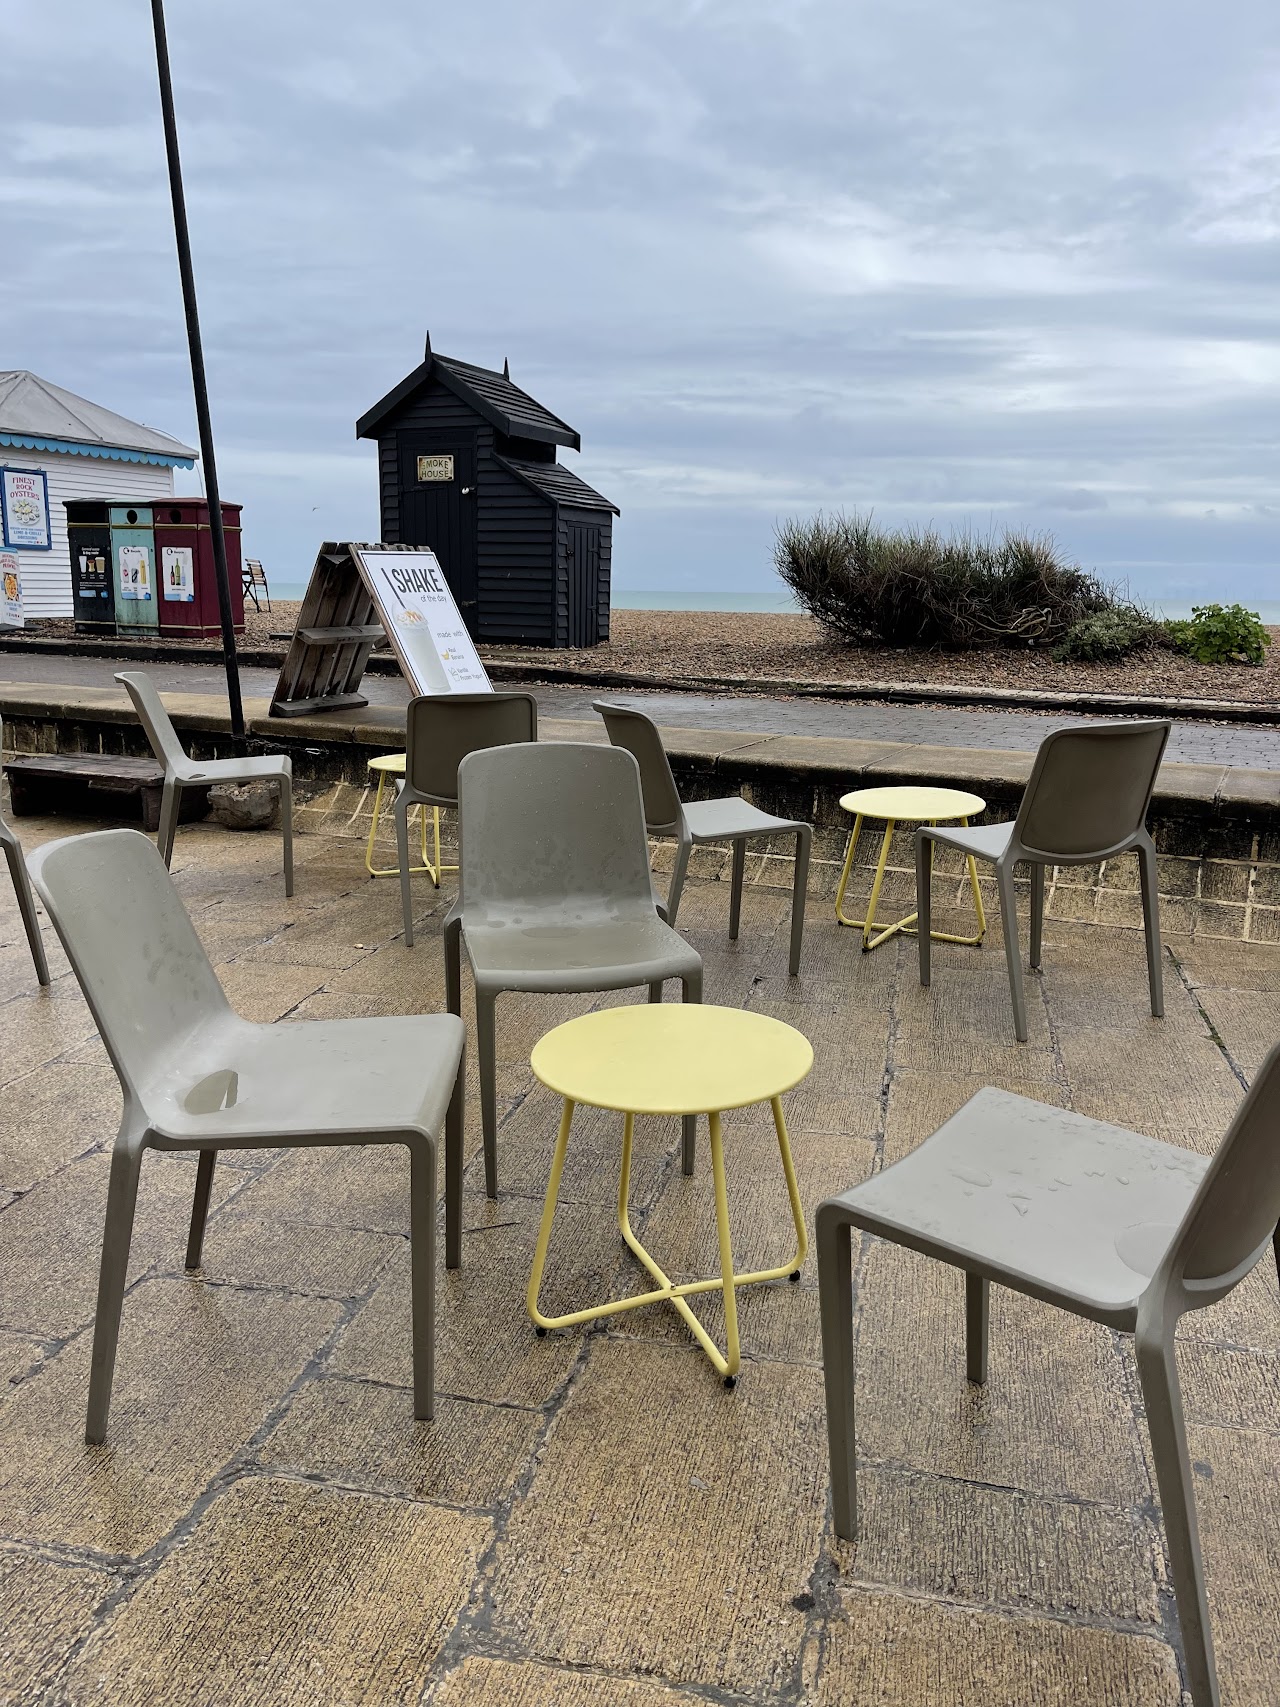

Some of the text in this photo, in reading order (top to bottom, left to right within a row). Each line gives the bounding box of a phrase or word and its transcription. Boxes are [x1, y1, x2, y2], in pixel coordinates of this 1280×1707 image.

[421, 470, 449, 478] HOUSE
[12, 477, 35, 486] FINEST
[10, 490, 40, 500] OYSTERS
[391, 568, 443, 593] SHAKE
[420, 594, 447, 603] of the day
